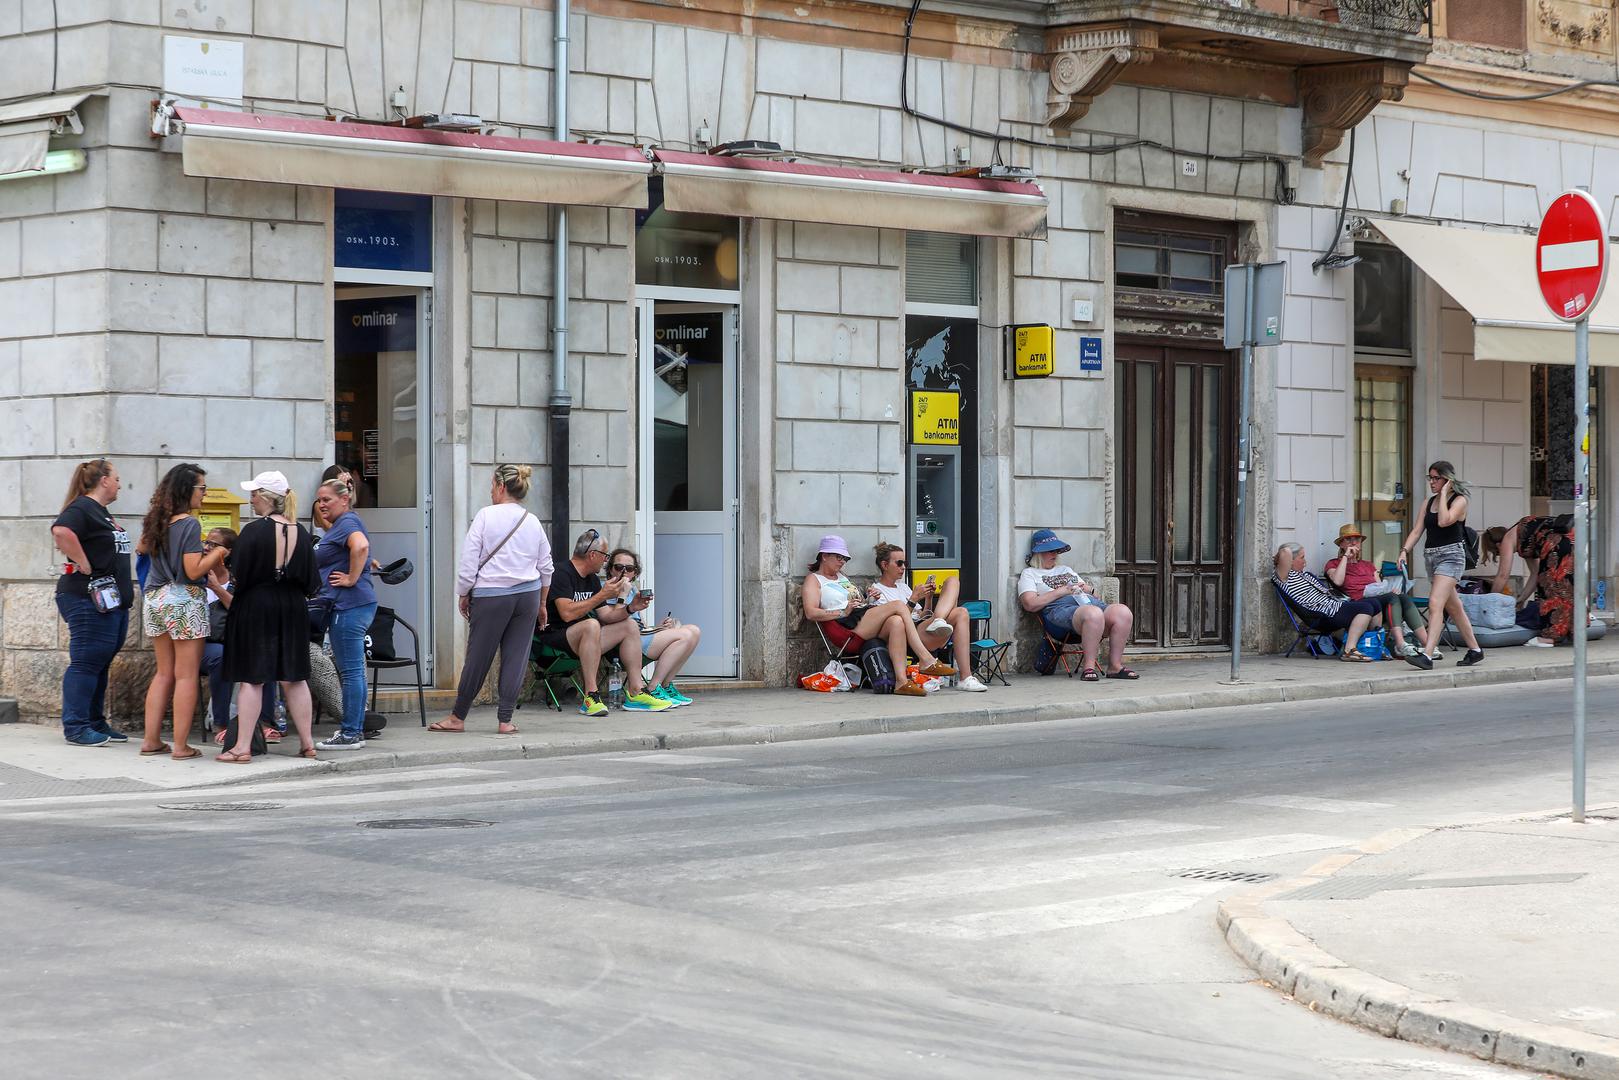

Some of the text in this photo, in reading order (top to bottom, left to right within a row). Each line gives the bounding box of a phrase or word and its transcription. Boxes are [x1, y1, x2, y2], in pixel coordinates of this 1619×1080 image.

[1079, 304, 1089, 316] 40
[362, 311, 398, 326] mlinar
[666, 325, 709, 339] mlinar
[1030, 353, 1047, 362] ATM
[1019, 363, 1047, 372] bankomat
[938, 418, 958, 429] ATM
[924, 431, 958, 440] bankomat
